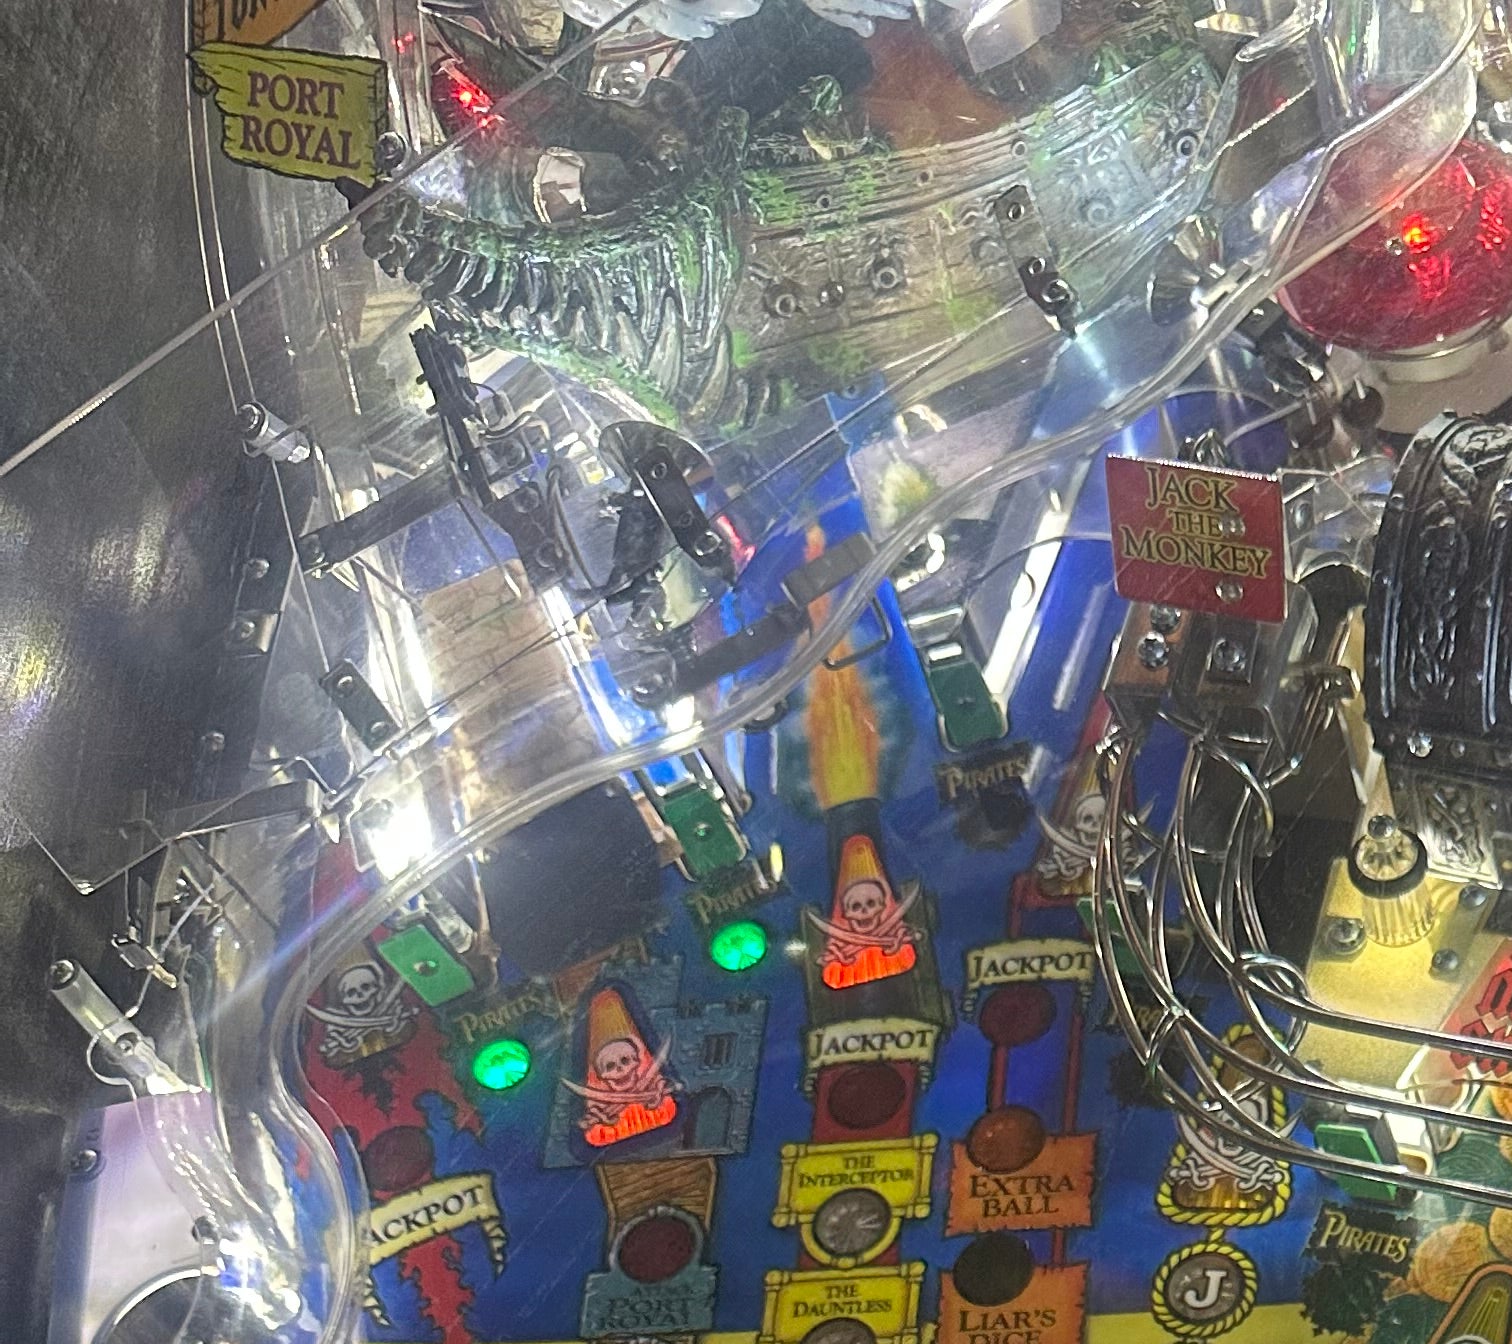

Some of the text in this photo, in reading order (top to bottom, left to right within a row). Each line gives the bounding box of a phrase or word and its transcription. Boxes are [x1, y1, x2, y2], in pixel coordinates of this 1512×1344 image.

[247, 70, 344, 120] PORT
[240, 115, 360, 169] ROYAL
[1145, 467, 1239, 513] JACK
[1172, 509, 1226, 537] THE
[1121, 525, 1272, 579] MONKEY
[968, 954, 1093, 984] JACKPOT
[810, 1030, 934, 1059] JACKPOT
[843, 1155, 876, 1170] THE
[799, 1169, 914, 1189] INTERCEPTOR
[969, 1173, 1075, 1199] EXTRA
[362, 1184, 485, 1248] ACKPOT
[982, 1195, 1060, 1218] BALL
[1321, 1211, 1412, 1264] PIRATES
[825, 1284, 860, 1298] THE
[1183, 1269, 1228, 1310] J
[793, 1300, 892, 1318] DAUNTLESS
[959, 1309, 1057, 1333] LIAR'S
